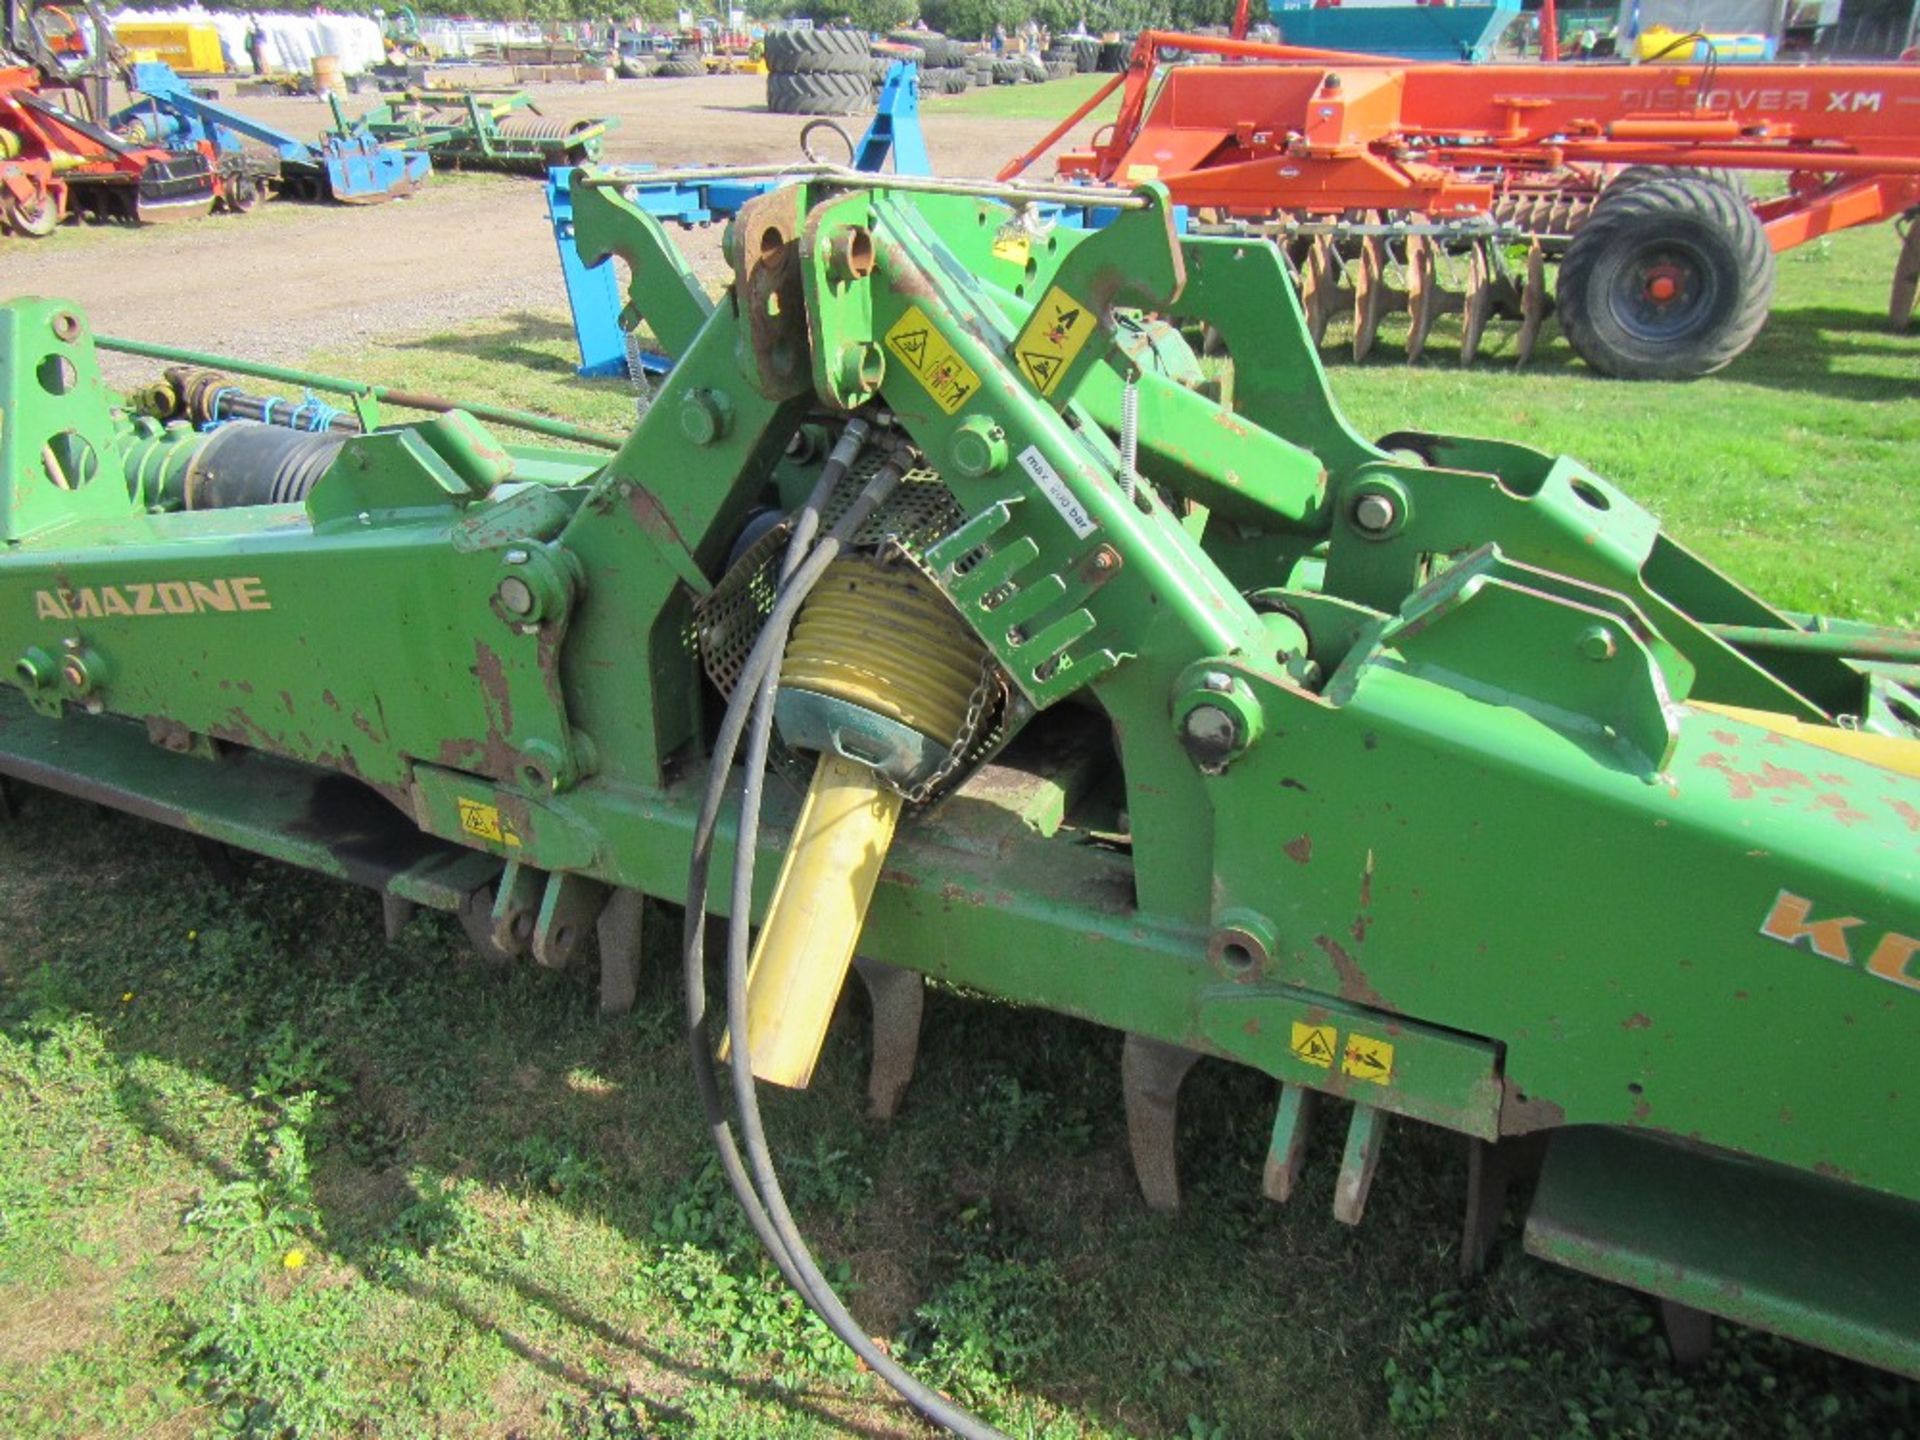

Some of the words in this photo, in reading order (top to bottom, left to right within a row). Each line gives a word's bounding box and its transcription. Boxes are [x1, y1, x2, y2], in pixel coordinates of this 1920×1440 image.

[1620, 89, 1810, 111] DISCOVER
[1825, 90, 1883, 112] XM
[1069, 506, 1087, 529] bar
[35, 577, 272, 620] AMAZONE
